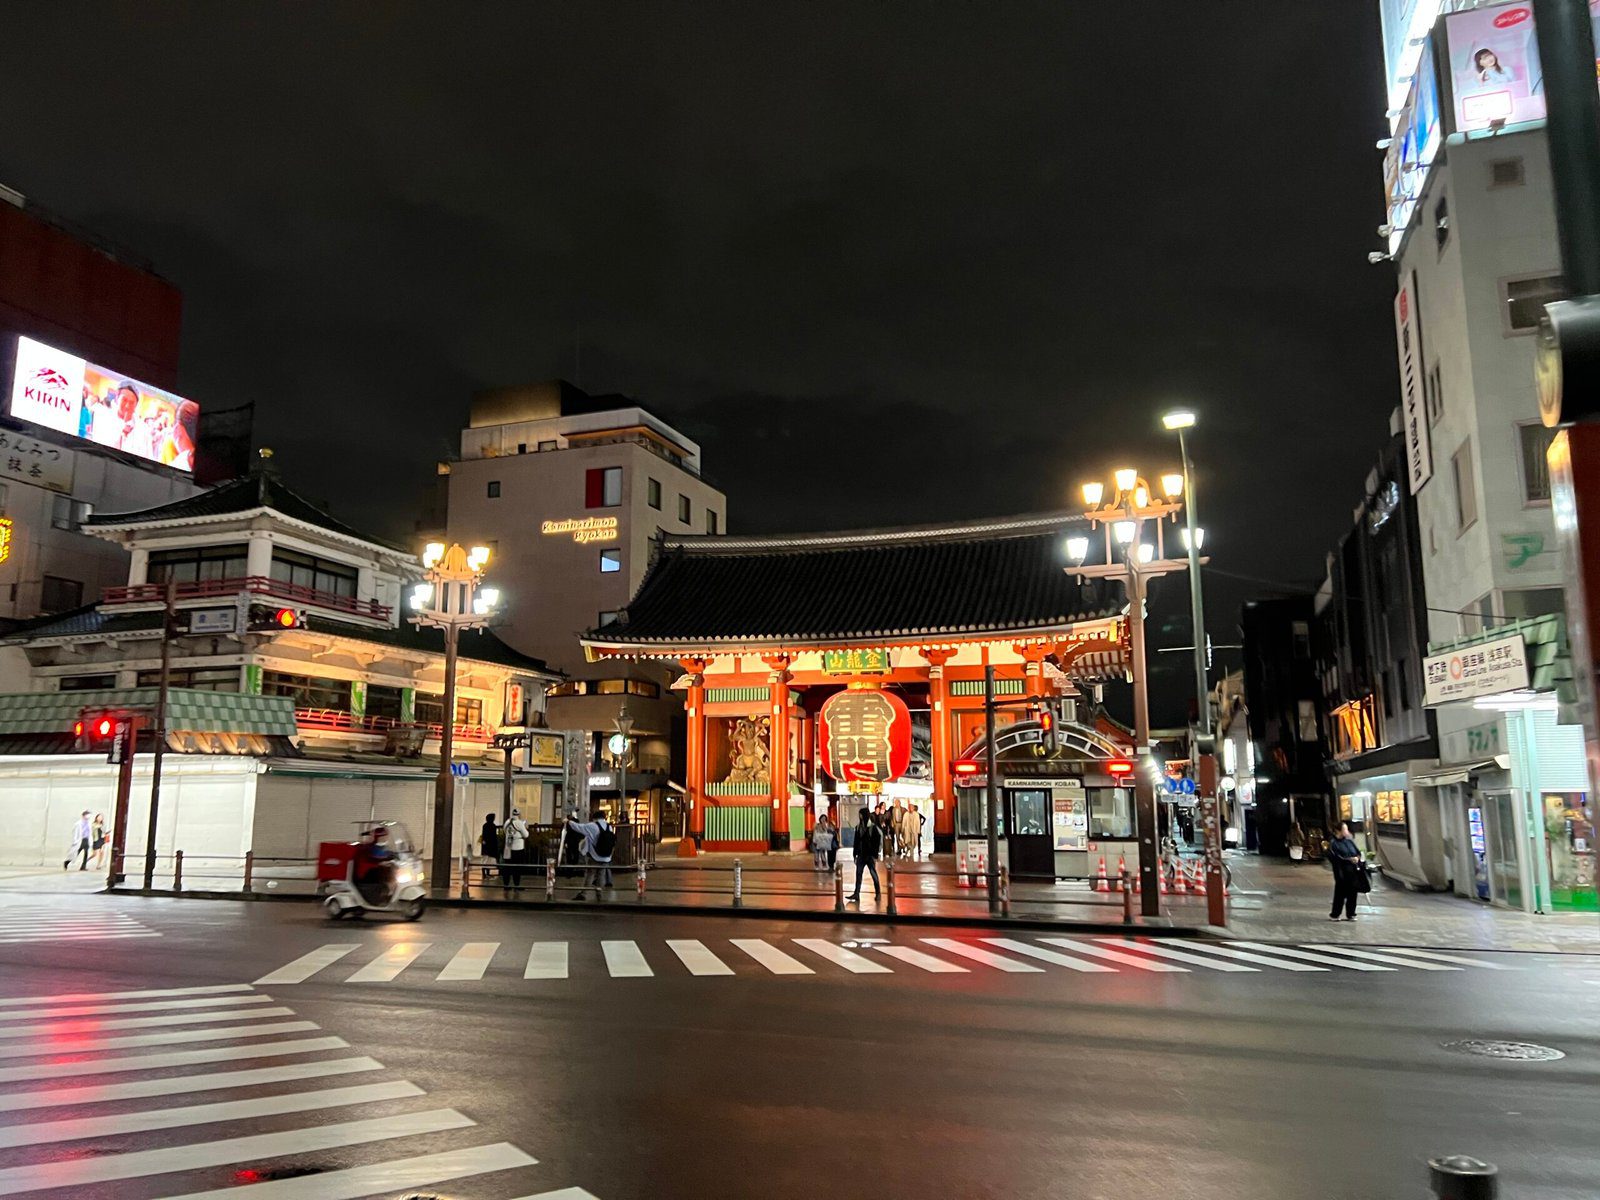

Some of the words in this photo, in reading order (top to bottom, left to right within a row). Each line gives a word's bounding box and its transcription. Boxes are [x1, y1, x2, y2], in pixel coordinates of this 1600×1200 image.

[25, 386, 71, 412] KIRIN
[542, 517, 618, 534] Kaminarimon
[574, 529, 618, 545] Ryokan
[824, 693, 896, 781] 雷門
[1007, 780, 1052, 788] KAMINARIMON
[1054, 780, 1077, 788] KOBAN
